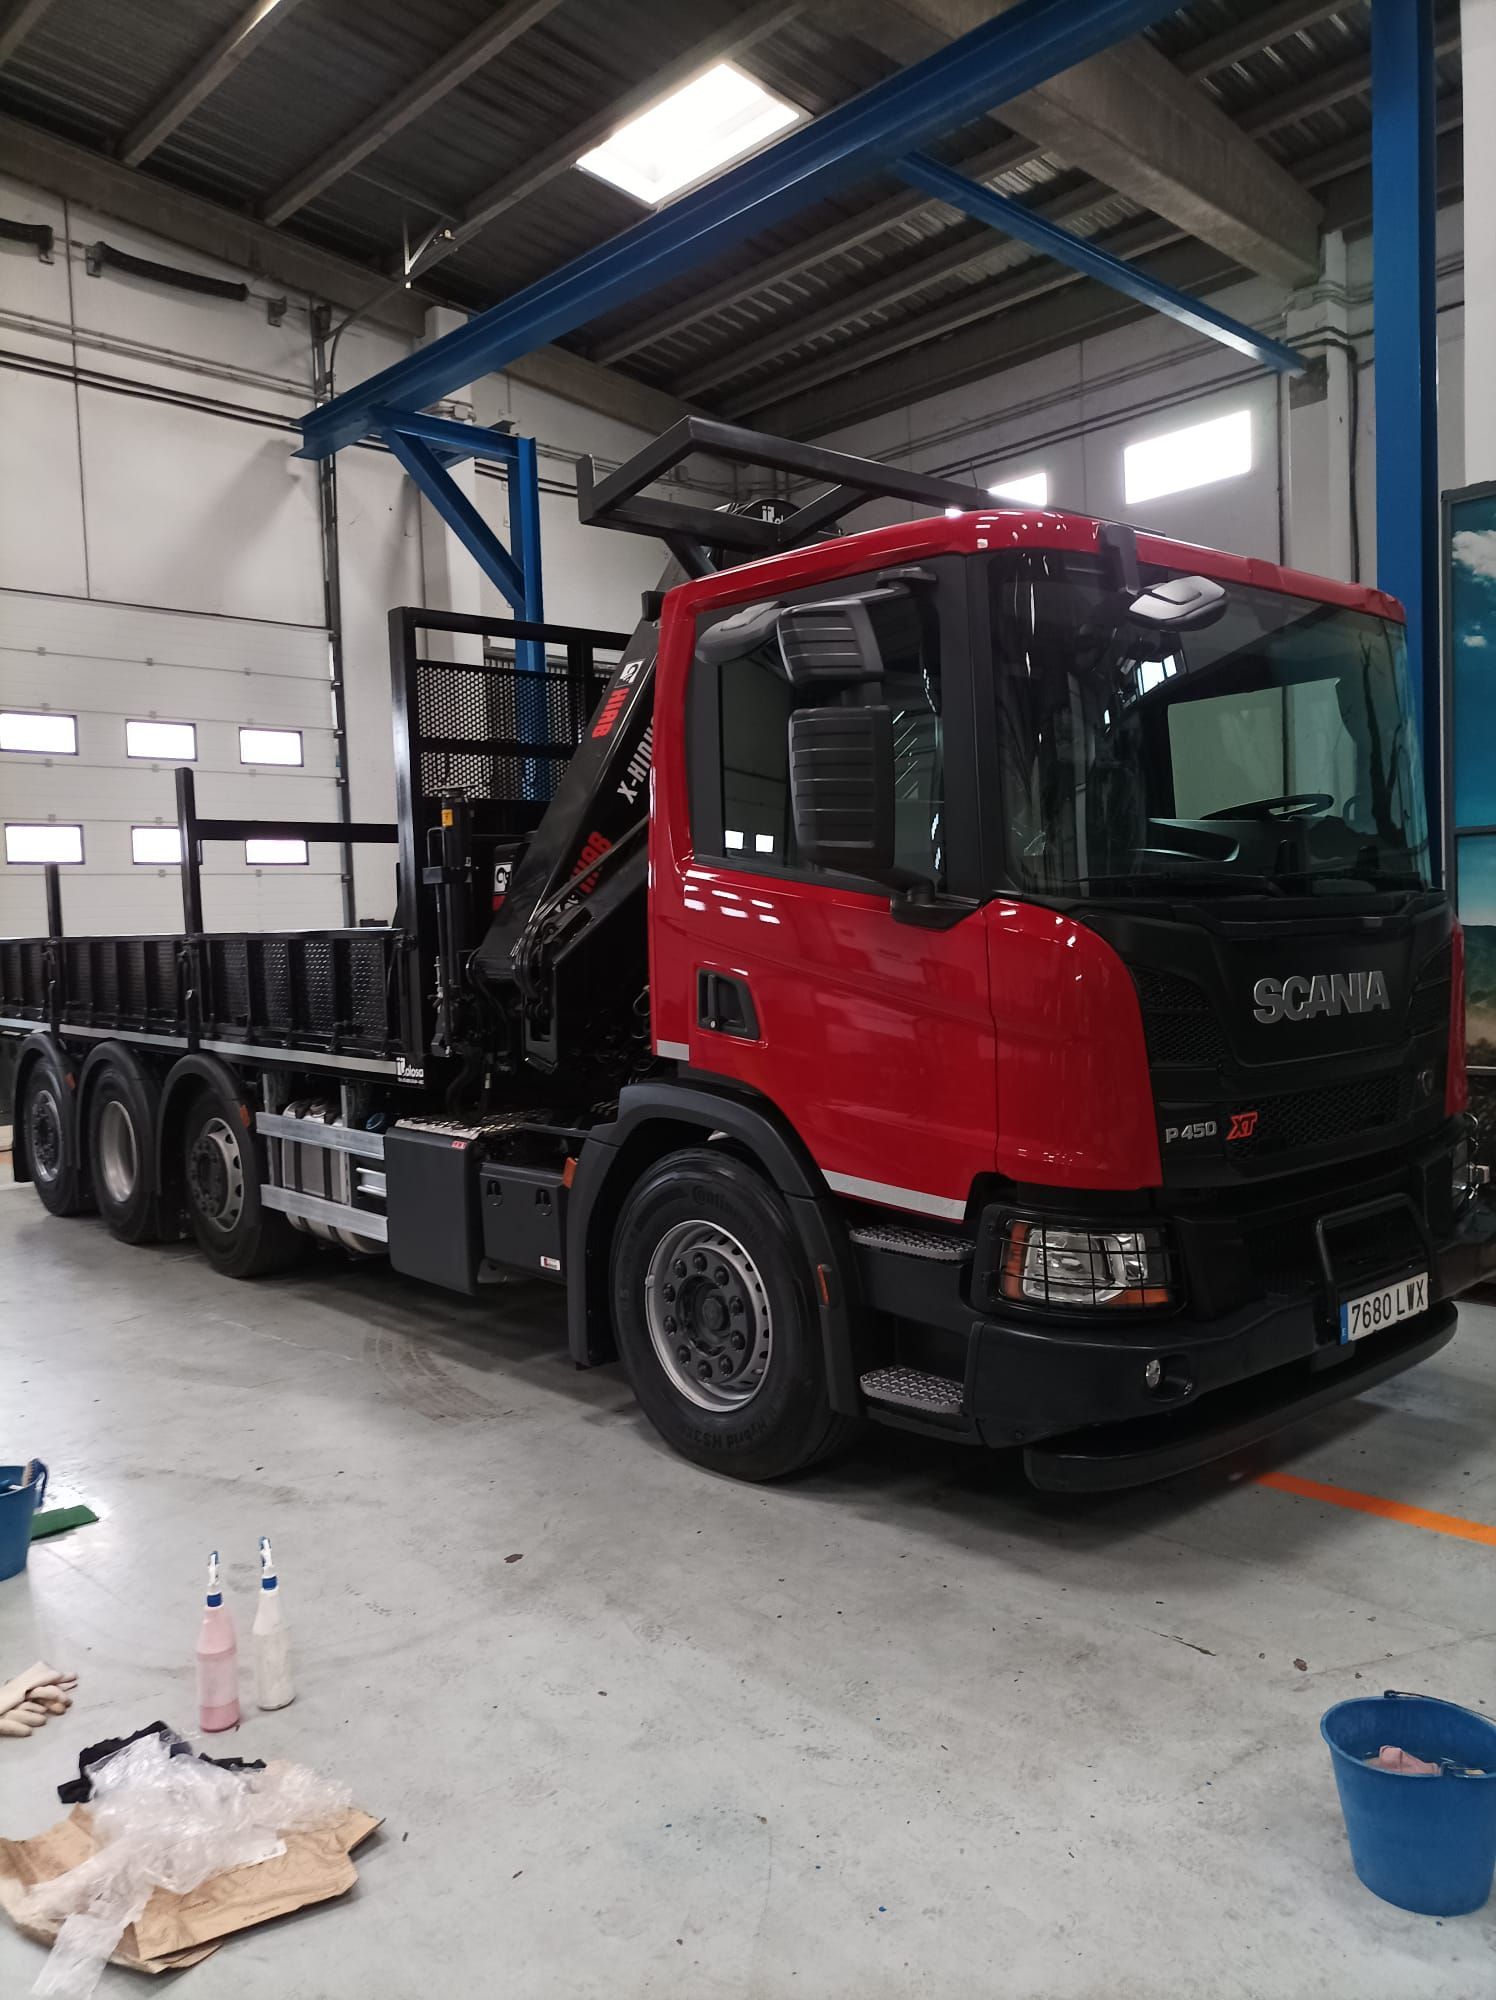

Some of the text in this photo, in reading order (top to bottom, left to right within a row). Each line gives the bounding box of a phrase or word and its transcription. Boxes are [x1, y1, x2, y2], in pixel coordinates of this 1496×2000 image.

[591, 687, 630, 738] HIAB
[616, 716, 655, 804] X-HID
[1253, 970, 1391, 1024] SCANIA
[1165, 1120, 1217, 1144] P 450
[1226, 1111, 1258, 1141] XT
[1351, 1293, 1391, 1335] 7680
[1396, 1279, 1424, 1316] LWX
